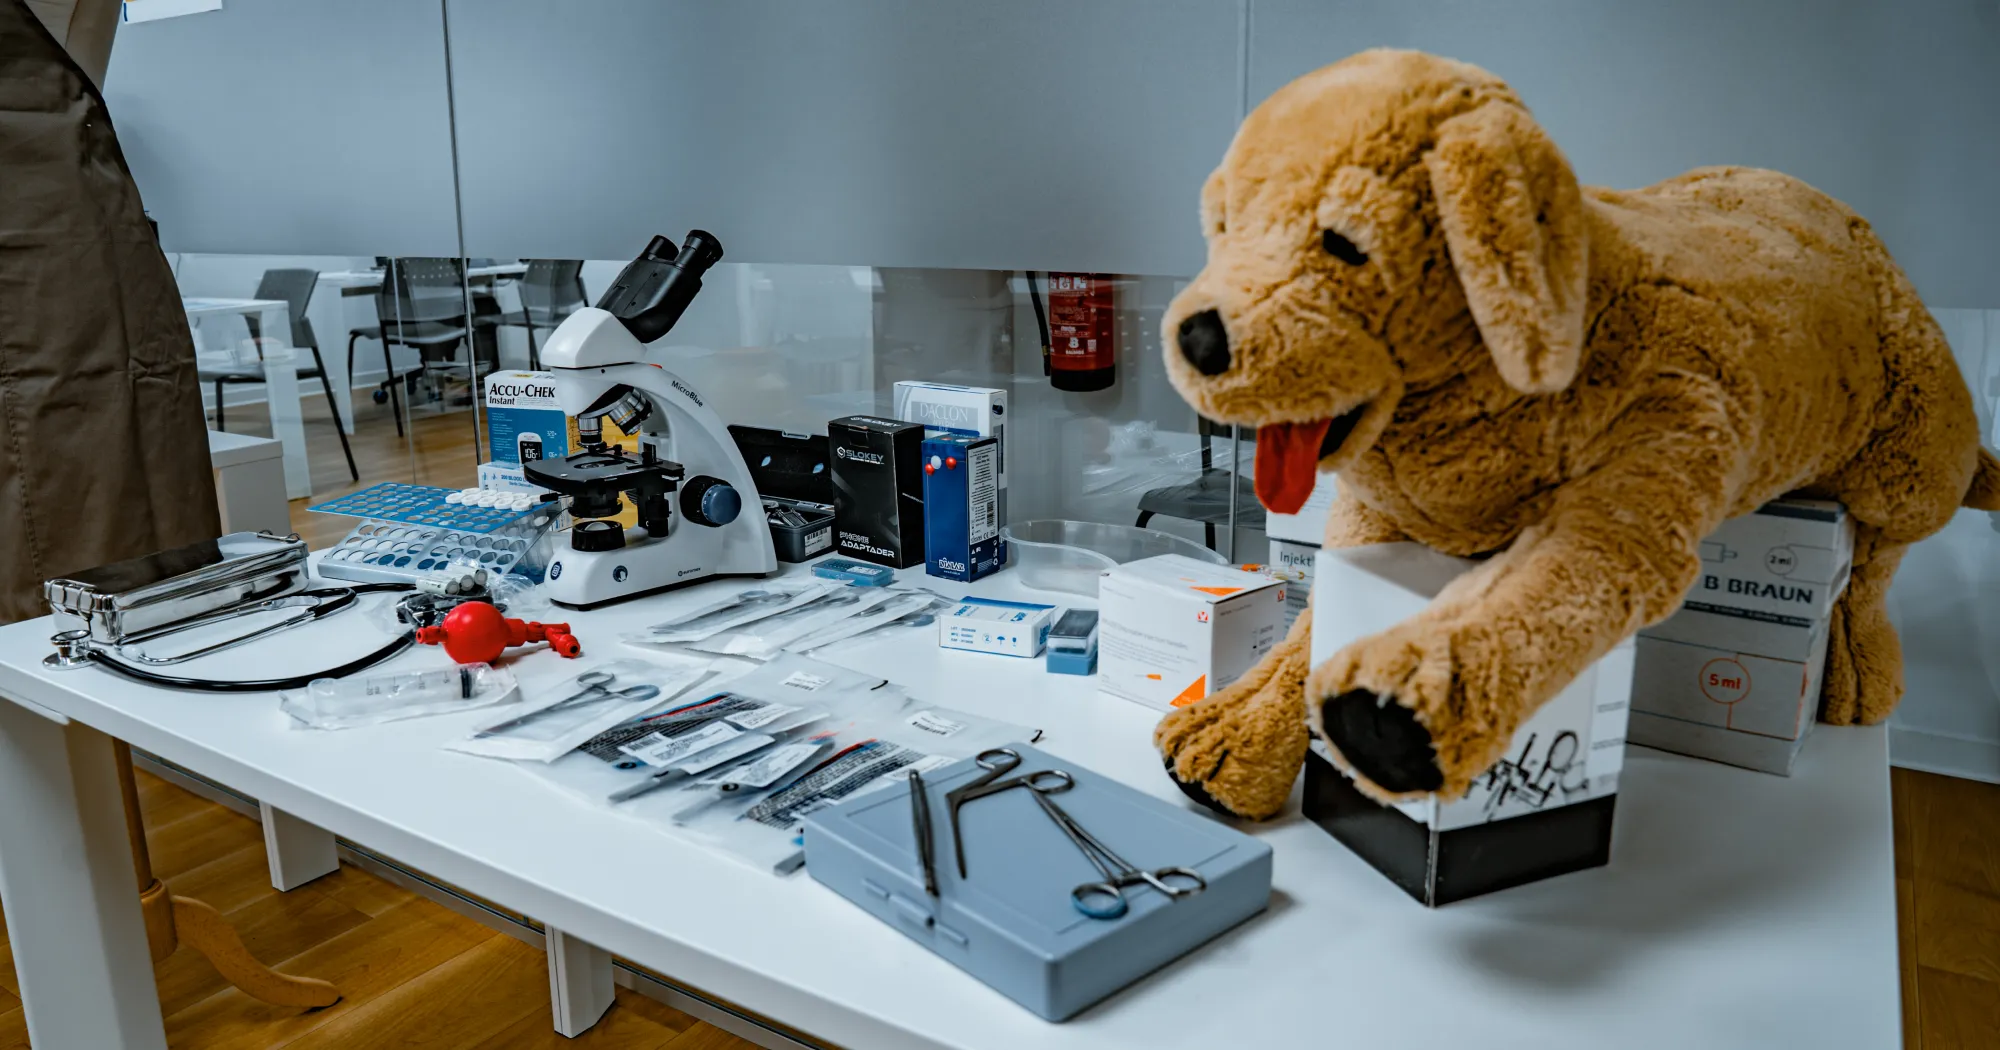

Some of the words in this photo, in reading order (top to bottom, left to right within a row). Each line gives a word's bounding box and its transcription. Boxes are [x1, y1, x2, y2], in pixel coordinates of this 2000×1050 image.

[489, 383, 556, 398] ACCU-CHEK
[671, 380, 703, 407] MicroBlue
[489, 396, 515, 405] Instant
[920, 402, 968, 422] DACLON
[845, 449, 884, 462] SLOKEY
[839, 531, 869, 544] PHONE
[840, 540, 895, 558] ADAPTADER
[1279, 551, 1311, 567] Injekt
[1704, 574, 1719, 591] B
[1727, 577, 1813, 604] BRAUN
[1709, 673, 1719, 686] 5
[1721, 677, 1741, 690] ml
